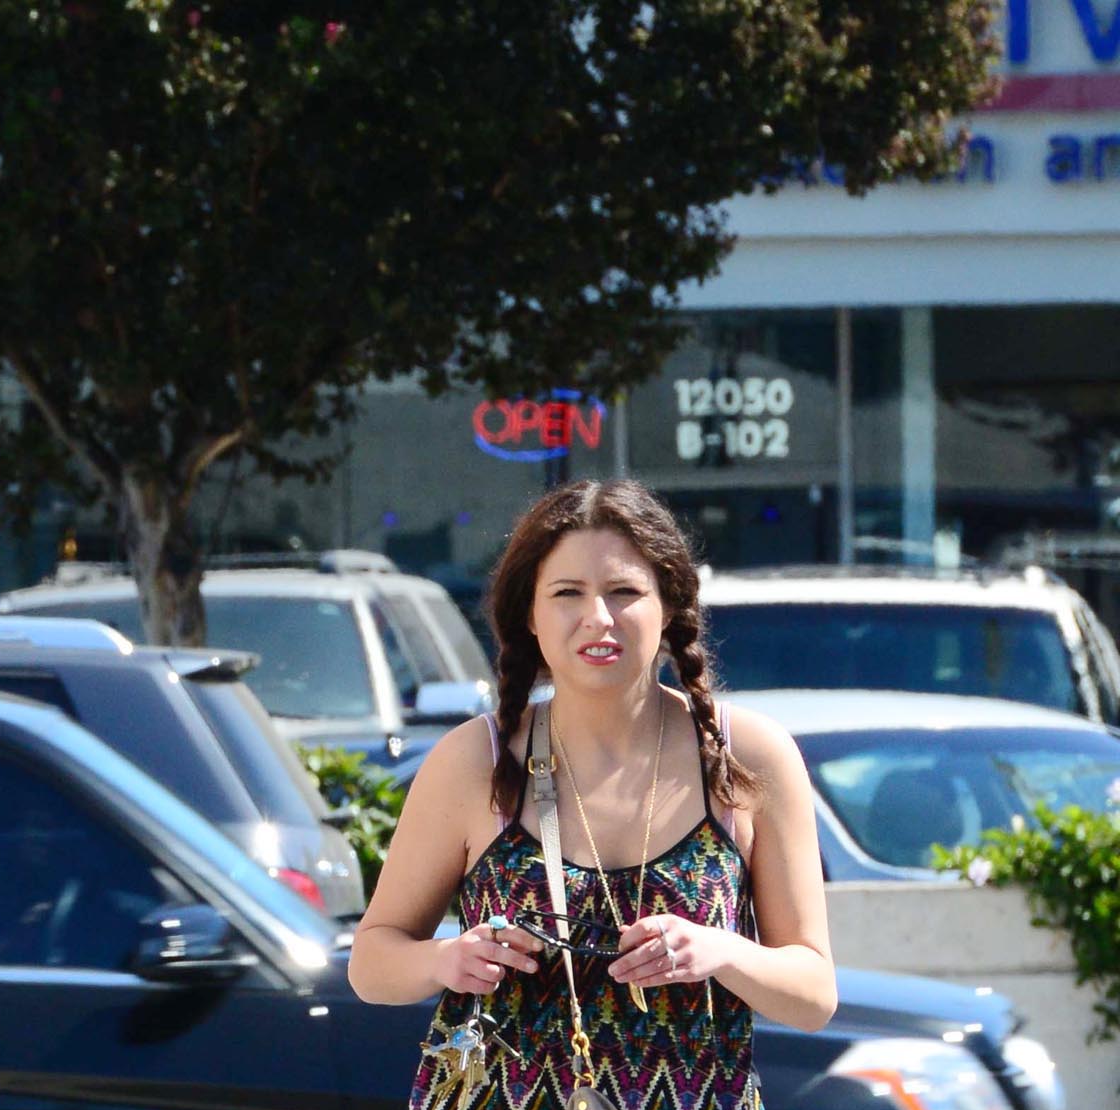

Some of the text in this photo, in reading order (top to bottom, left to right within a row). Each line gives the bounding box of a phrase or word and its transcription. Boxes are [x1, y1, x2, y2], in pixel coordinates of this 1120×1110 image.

[675, 378, 794, 417] 12050
[472, 399, 602, 449] OPEN
[676, 418, 789, 459] B-102
